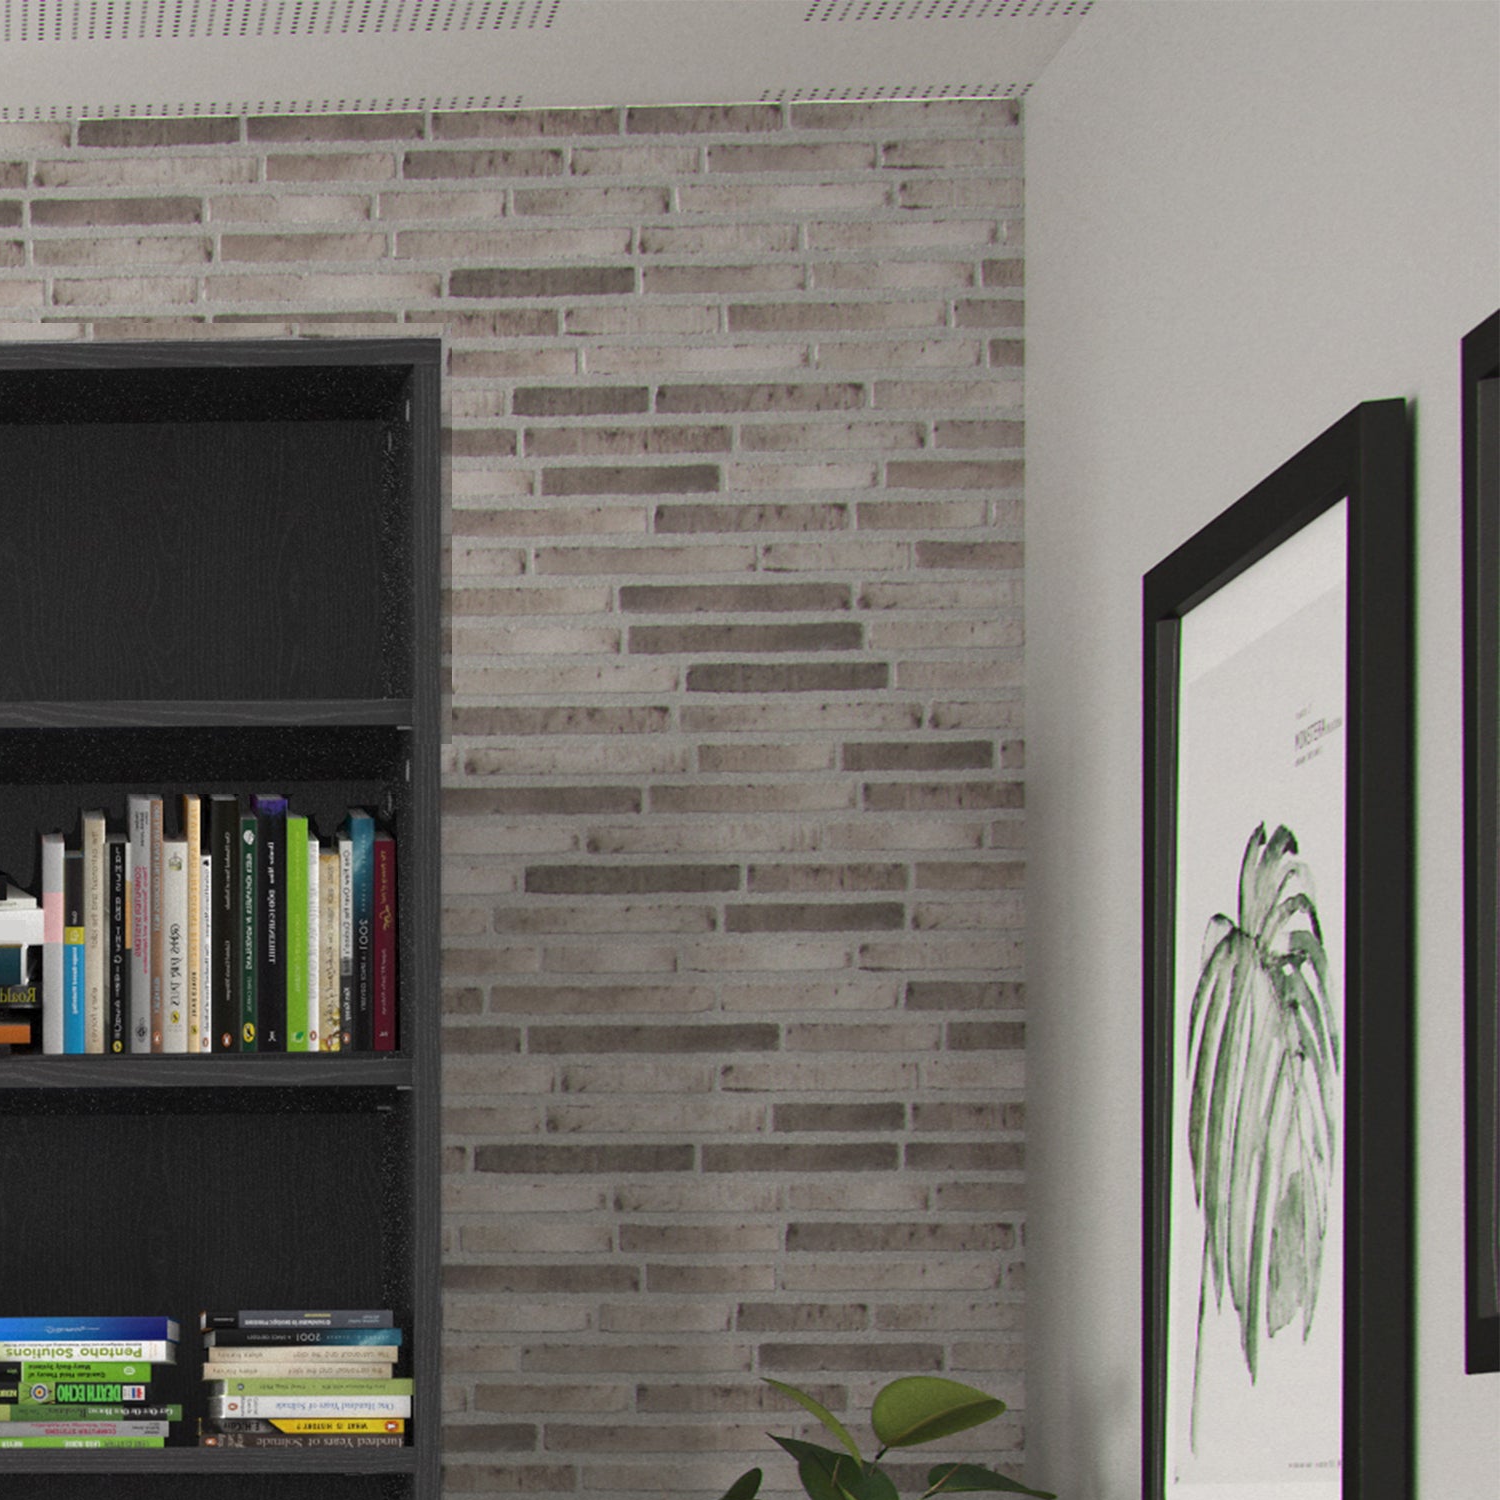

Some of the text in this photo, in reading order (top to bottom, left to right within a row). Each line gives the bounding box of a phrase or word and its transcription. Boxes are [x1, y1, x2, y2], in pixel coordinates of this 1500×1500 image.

[5, 1347, 143, 1359] Pentaho Solutions
[55, 1384, 122, 1402] DEATH ECHO
[347, 1422, 369, 1430] WHAT
[323, 1437, 354, 1449] Years
